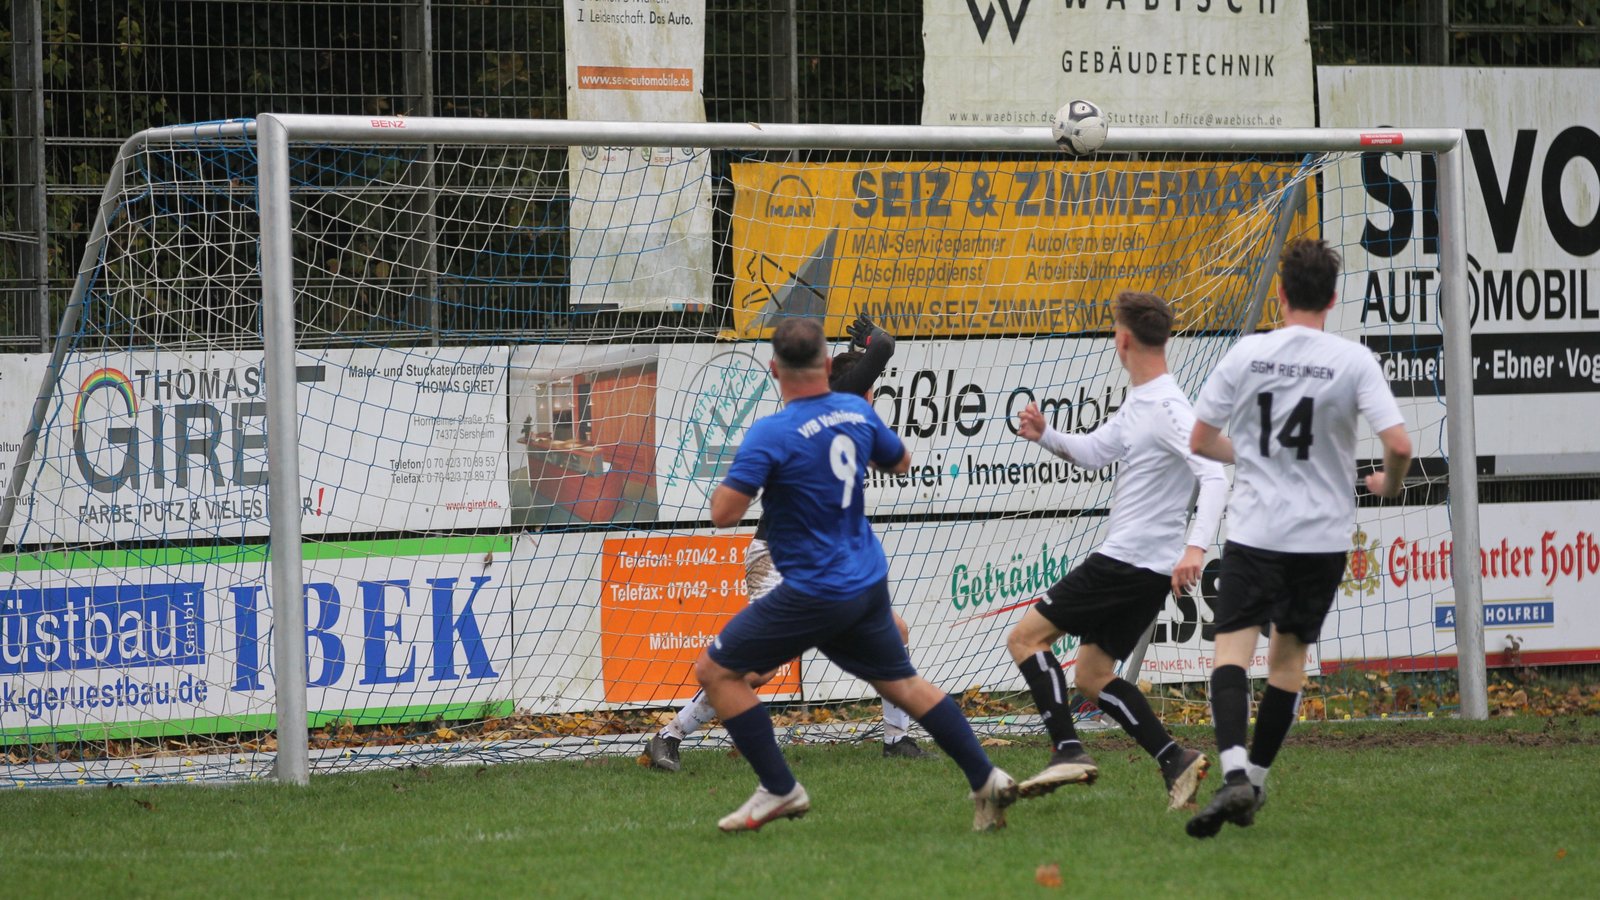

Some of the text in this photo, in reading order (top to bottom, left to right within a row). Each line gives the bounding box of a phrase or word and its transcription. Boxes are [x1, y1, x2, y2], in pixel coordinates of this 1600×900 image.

[590, 9, 646, 24] Leidenschaft.
[649, 11, 665, 25] Das
[668, 12, 693, 25] Auto.
[1062, 46, 1275, 77] GEBÄUDETECHNIK
[370, 119, 406, 128] BENZ
[1107, 112, 1159, 126] Stuttgart
[1173, 113, 1282, 126] office@waebisch.de
[852, 171, 952, 219] SEIZ
[967, 171, 999, 218] &
[769, 205, 812, 217] MAN
[852, 233, 1006, 256] MAN-Servicepartner
[1026, 232, 1145, 252] Autokranverleih
[852, 261, 983, 284] Abschleppdienst
[1360, 269, 1600, 323] AUTMOBIL
[348, 363, 494, 378] Maler- und Stuckateurbetrieb
[1250, 360, 1275, 375] SGM
[1493, 350, 1554, 380] Ebner
[135, 366, 260, 401] THOMAS
[415, 379, 494, 394] THOMAS GIRET
[435, 428, 495, 440] 74372 Sersheim
[798, 419, 822, 439] VfB
[1257, 391, 1314, 461] 14
[390, 459, 424, 469] Telefon:
[829, 433, 857, 509] 9
[391, 473, 424, 484] Telefax:
[143, 502, 184, 522] PUTZ
[190, 501, 200, 519] &
[206, 499, 263, 519] VIELES
[618, 550, 671, 569] Telefon:
[676, 548, 717, 566] 07042
[729, 547, 737, 564] 8
[610, 583, 663, 601] Telefax:
[667, 581, 708, 599] 07042
[720, 580, 728, 597] 8
[2, 597, 177, 664] üstbau
[183, 592, 196, 656] GmbH
[229, 576, 499, 691] IBEK
[1143, 658, 1196, 672] TRINKEN.
[3, 673, 208, 719] k-geruestbau.de
